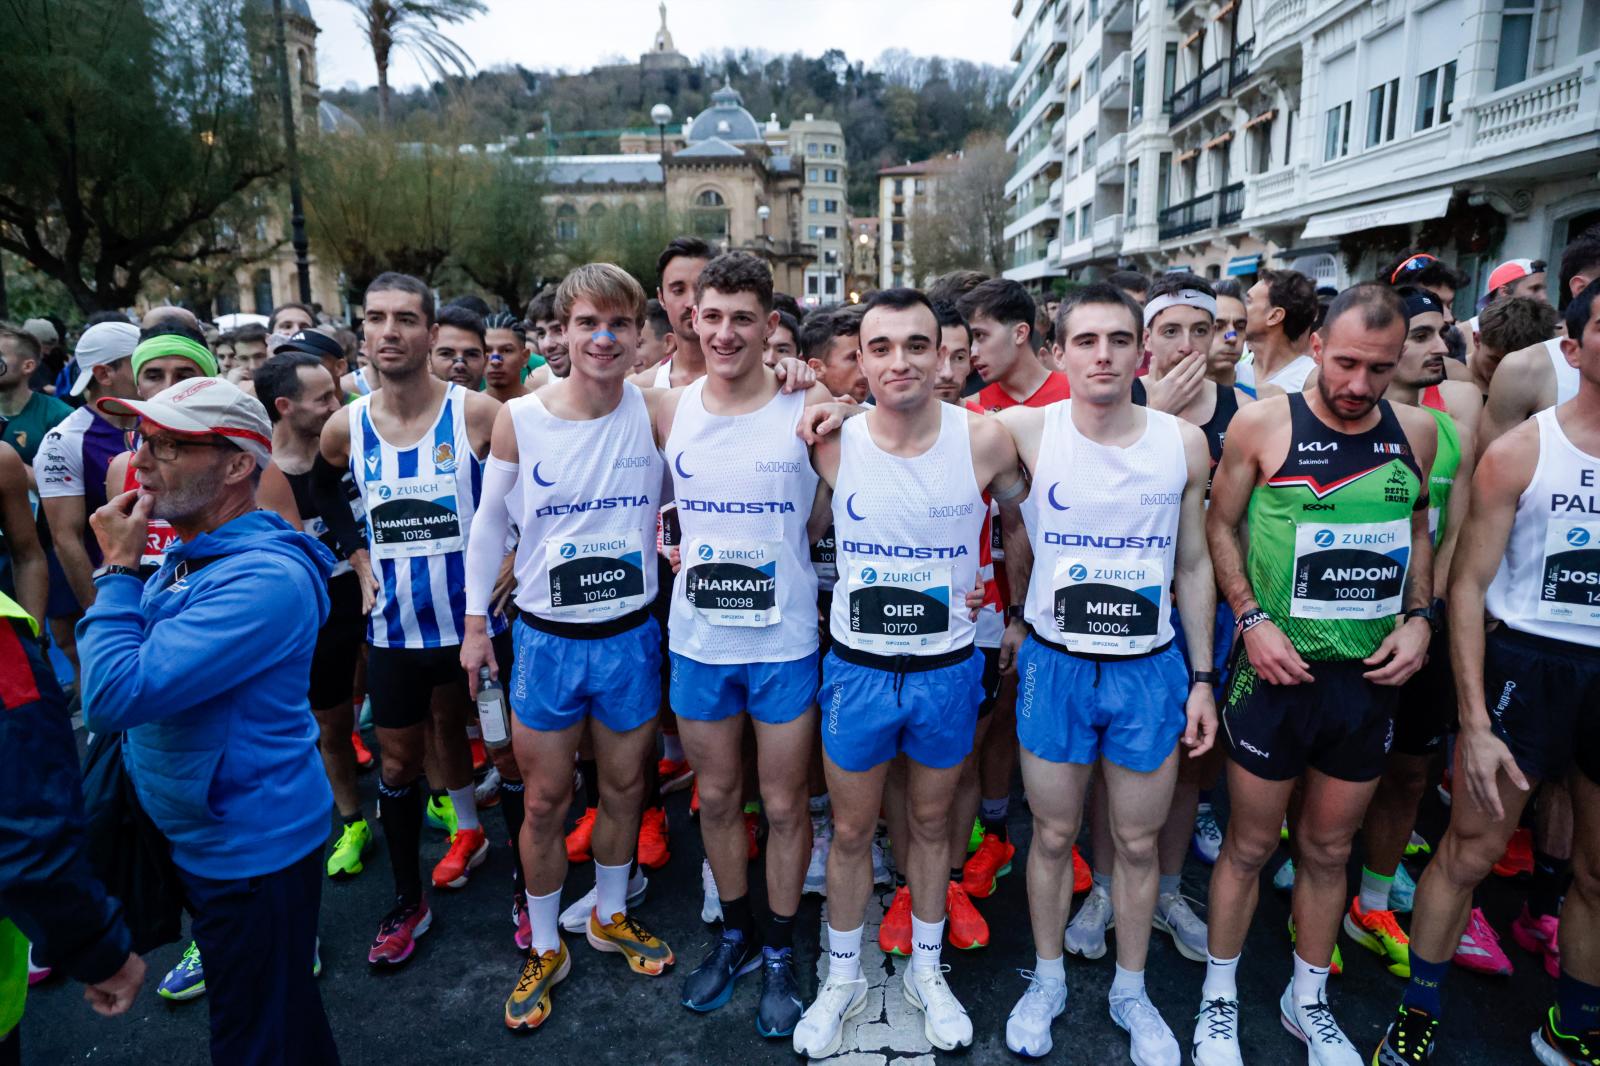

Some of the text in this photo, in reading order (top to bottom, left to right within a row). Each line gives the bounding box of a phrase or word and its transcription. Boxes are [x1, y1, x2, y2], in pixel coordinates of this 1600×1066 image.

[612, 456, 651, 469] MHN
[755, 461, 800, 473] MHN
[1580, 469, 1594, 487] E
[396, 483, 439, 496] ZURICH
[535, 495, 650, 518] DONOSTIA
[929, 503, 974, 518] MHN
[381, 513, 459, 529] MANUEL MARÍA
[401, 529, 432, 541] 10126
[1044, 531, 1172, 549] DONOSTIA
[1342, 532, 1395, 544] ZURICH
[582, 539, 626, 554] ZURICH
[842, 540, 968, 559] DONOSTIA
[718, 550, 764, 560] ZURICH
[580, 569, 625, 587] HUGO
[883, 571, 931, 583] ZURICH
[1094, 569, 1145, 580] ZURICH
[1321, 566, 1399, 581] ANDONI
[1559, 569, 1600, 585] JOS
[698, 577, 775, 592] HARKAITZ
[1297, 581, 1307, 597] 10k
[1545, 582, 1557, 599] 10k
[552, 592, 562, 606] 10k
[583, 587, 617, 602] 10140
[1335, 587, 1376, 599] 10001
[715, 597, 754, 608] 10098
[1086, 601, 1141, 617] MIKEL
[883, 604, 925, 617] OIER
[851, 616, 860, 631] 10k
[882, 622, 918, 634] 10170
[1056, 615, 1065, 630] 10k
[1087, 621, 1130, 635] 10004
[1497, 680, 1517, 711] Castilla
